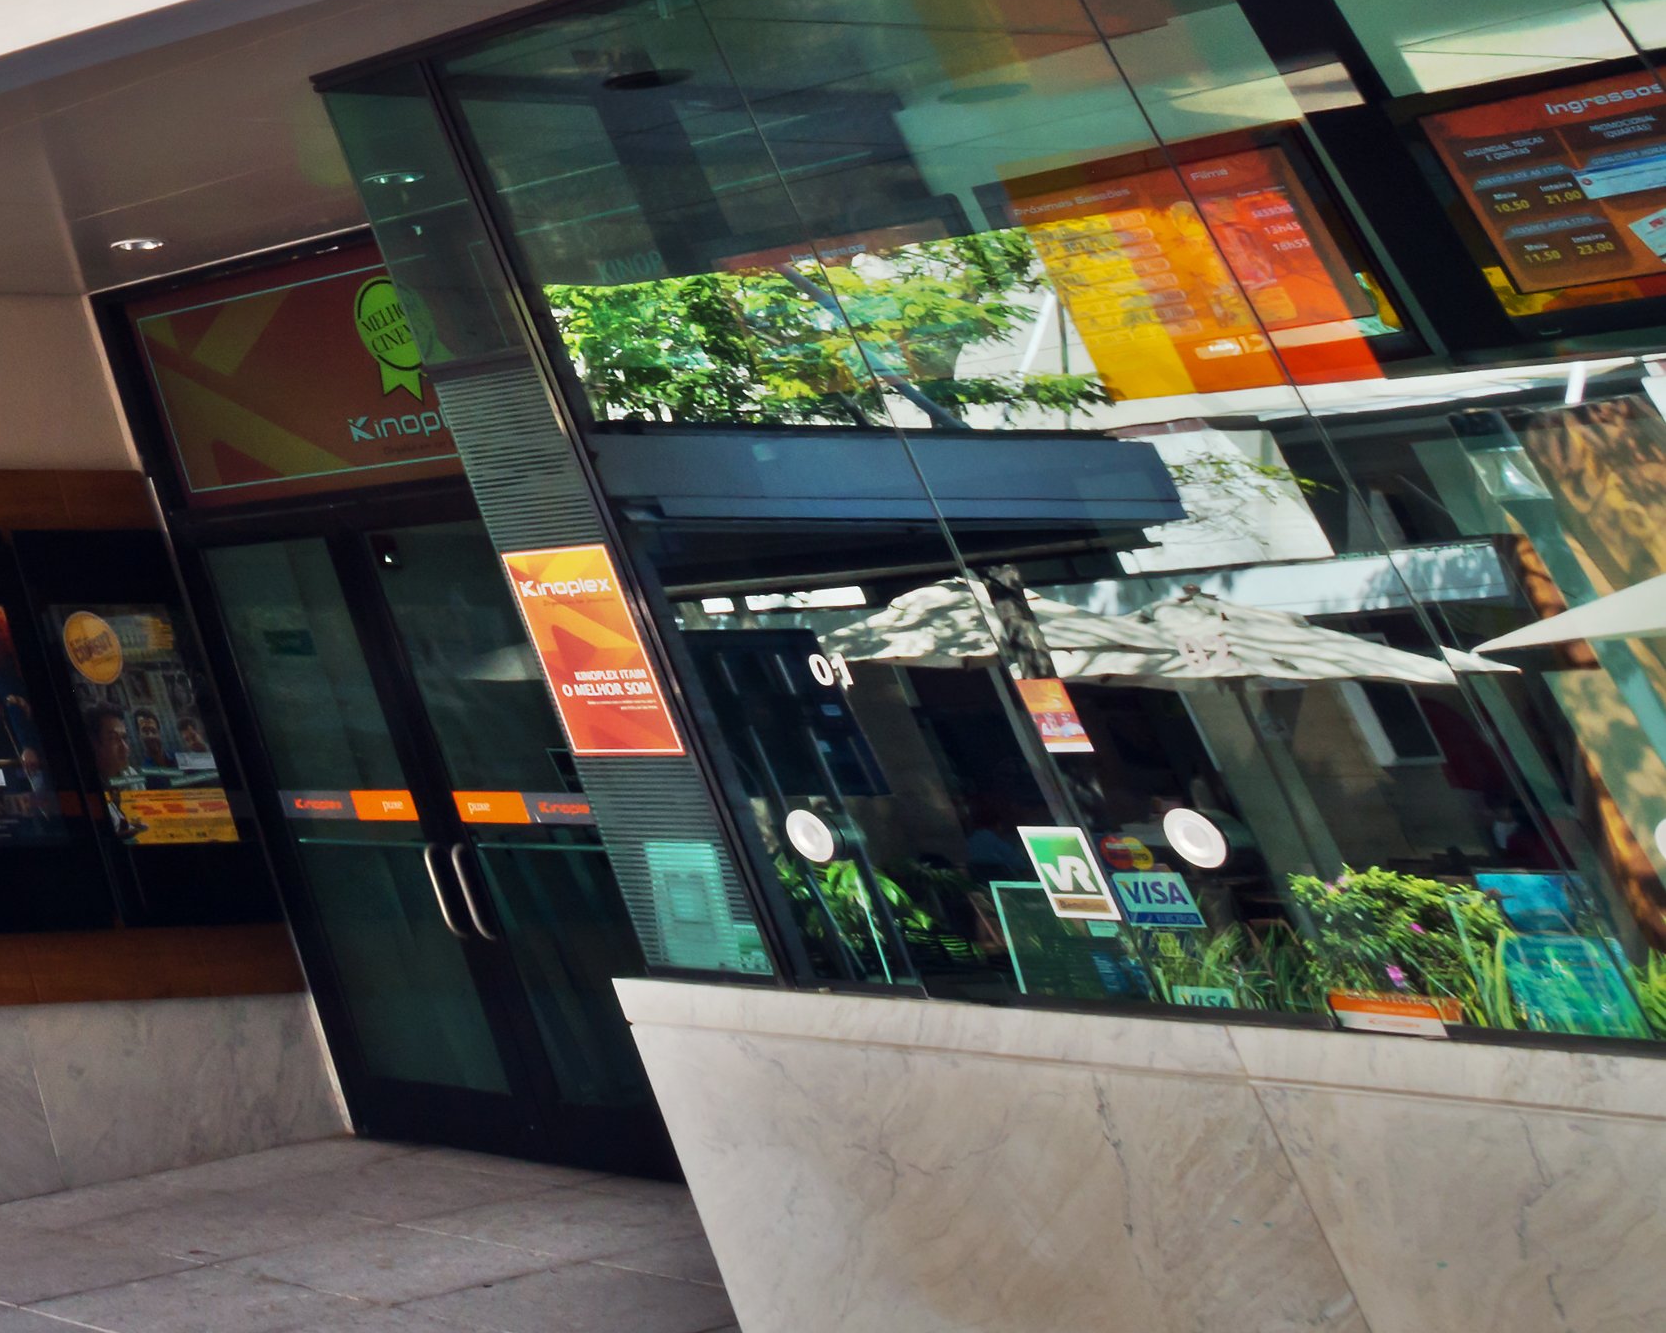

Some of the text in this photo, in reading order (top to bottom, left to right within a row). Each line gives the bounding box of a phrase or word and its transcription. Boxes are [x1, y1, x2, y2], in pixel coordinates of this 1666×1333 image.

[1545, 82, 1664, 115] Ingressos
[518, 577, 612, 598] Kinoplex
[574, 670, 620, 681] KINOPLEX
[808, 652, 854, 686] 01
[562, 681, 654, 697] O MELHOR SOM
[382, 800, 404, 813] puxe
[467, 801, 491, 815] puxe
[1117, 880, 1189, 906] VISA
